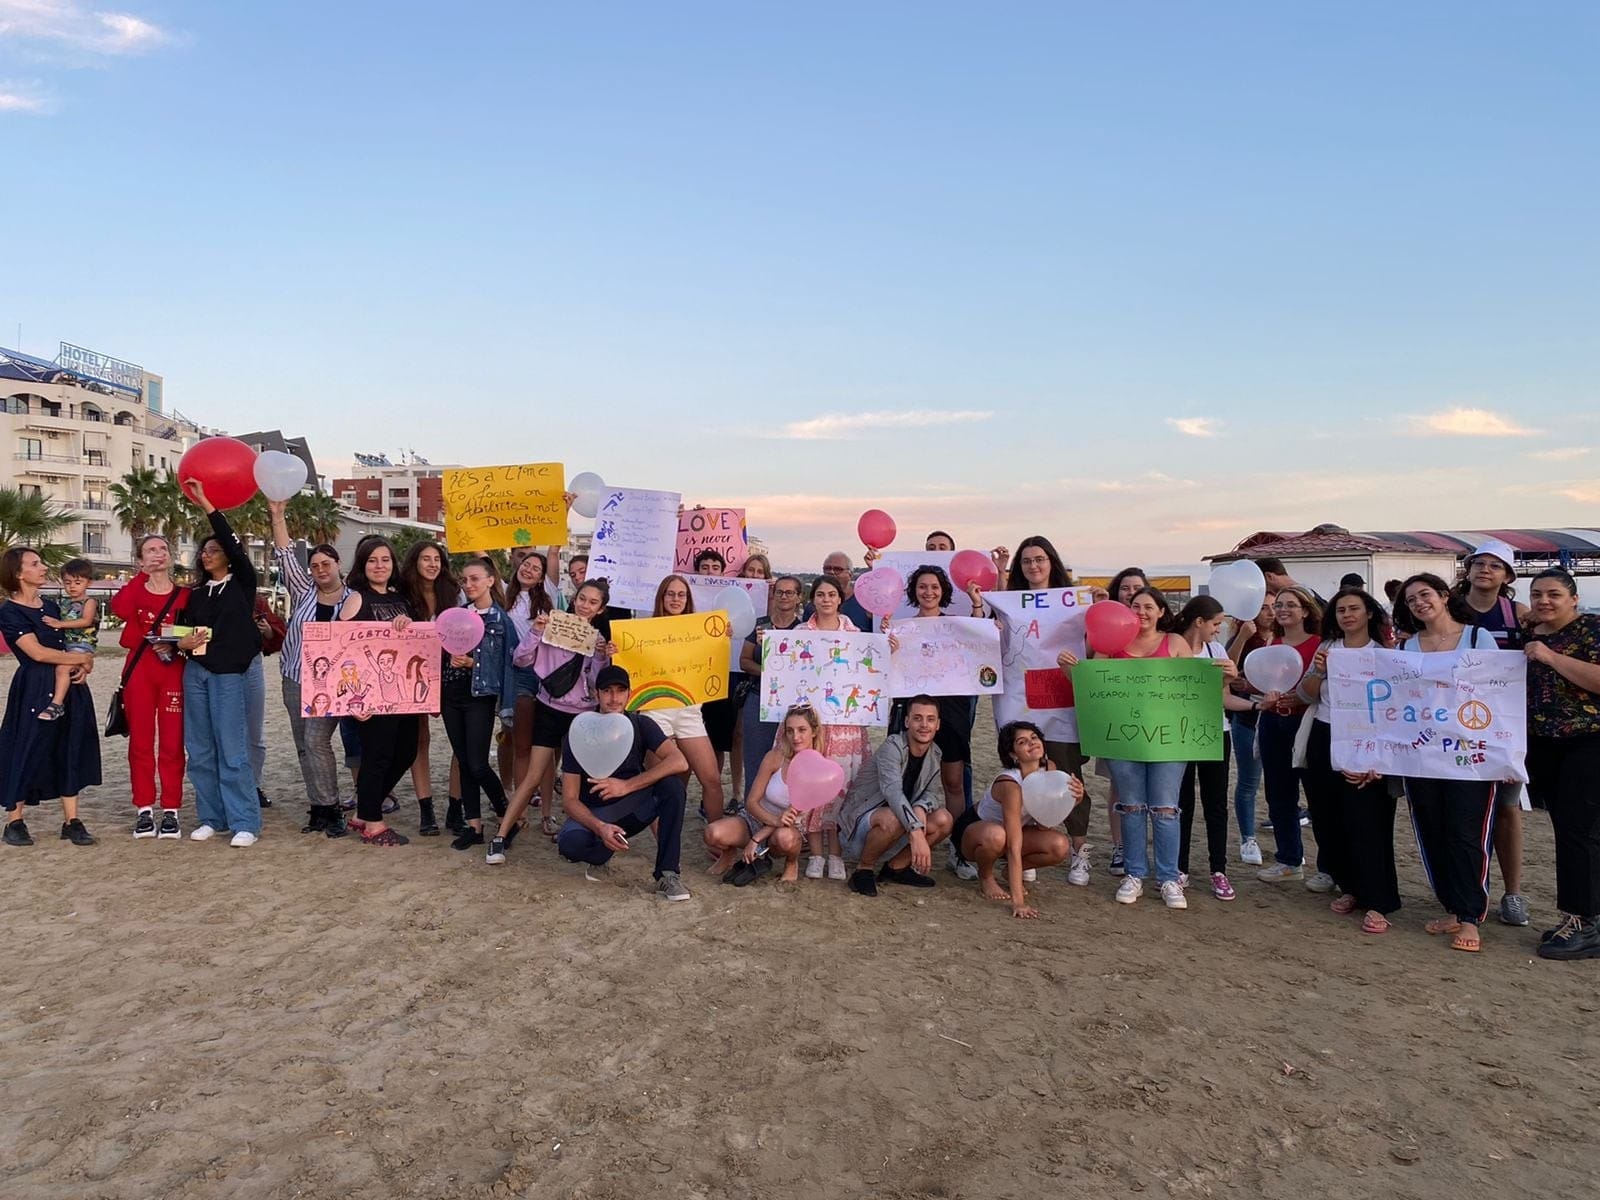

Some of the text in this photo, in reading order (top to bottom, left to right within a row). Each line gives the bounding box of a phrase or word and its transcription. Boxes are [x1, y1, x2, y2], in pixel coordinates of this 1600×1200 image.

[63, 345, 101, 367] HOTEL
[472, 484, 515, 502] focus
[536, 501, 560, 513] not
[678, 512, 730, 533] LOVE
[701, 535, 732, 545] never
[349, 629, 391, 641] LGBTQ
[1366, 679, 1449, 724] Peace
